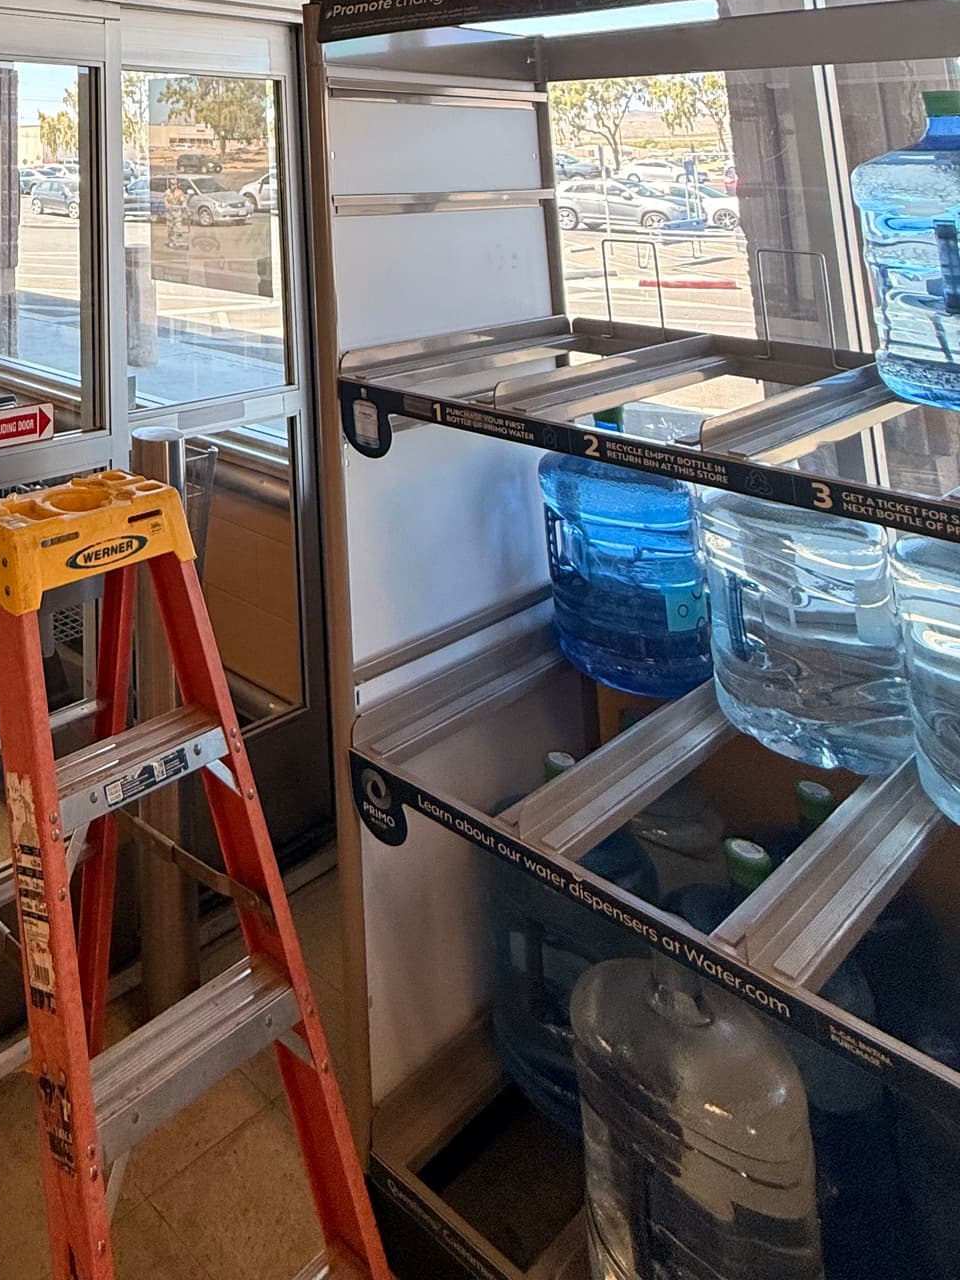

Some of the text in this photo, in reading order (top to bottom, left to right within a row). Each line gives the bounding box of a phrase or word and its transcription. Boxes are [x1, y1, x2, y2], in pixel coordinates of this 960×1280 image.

[433, 402, 442, 422] 1
[505, 419, 525, 431] FIRST
[18, 419, 34, 432] DOOR
[446, 415, 471, 427] BOTTLE
[508, 428, 534, 441] WATER
[583, 434, 600, 457] 2
[606, 441, 726, 474] RECYCLE EMPTY BOTTLE IN
[607, 451, 729, 484] RETURN BIN AT THIS STORE
[811, 482, 833, 509] 3
[842, 491, 865, 503] GET
[866, 497, 875, 506] A
[876, 499, 920, 516] TICKET
[922, 508, 948, 522] FOR
[843, 503, 874, 517] NEXT
[875, 508, 922, 527] BOTTLE
[925, 520, 945, 531] OF
[83, 540, 134, 563] WERNER
[363, 801, 395, 827] PRIMO
[418, 794, 453, 825] Learn
[455, 818, 495, 847] about
[497, 843, 521, 863] our
[524, 856, 567, 888] water
[569, 876, 658, 943] dispensers
[662, 936, 681, 955] at
[684, 944, 790, 1018] Water.com
